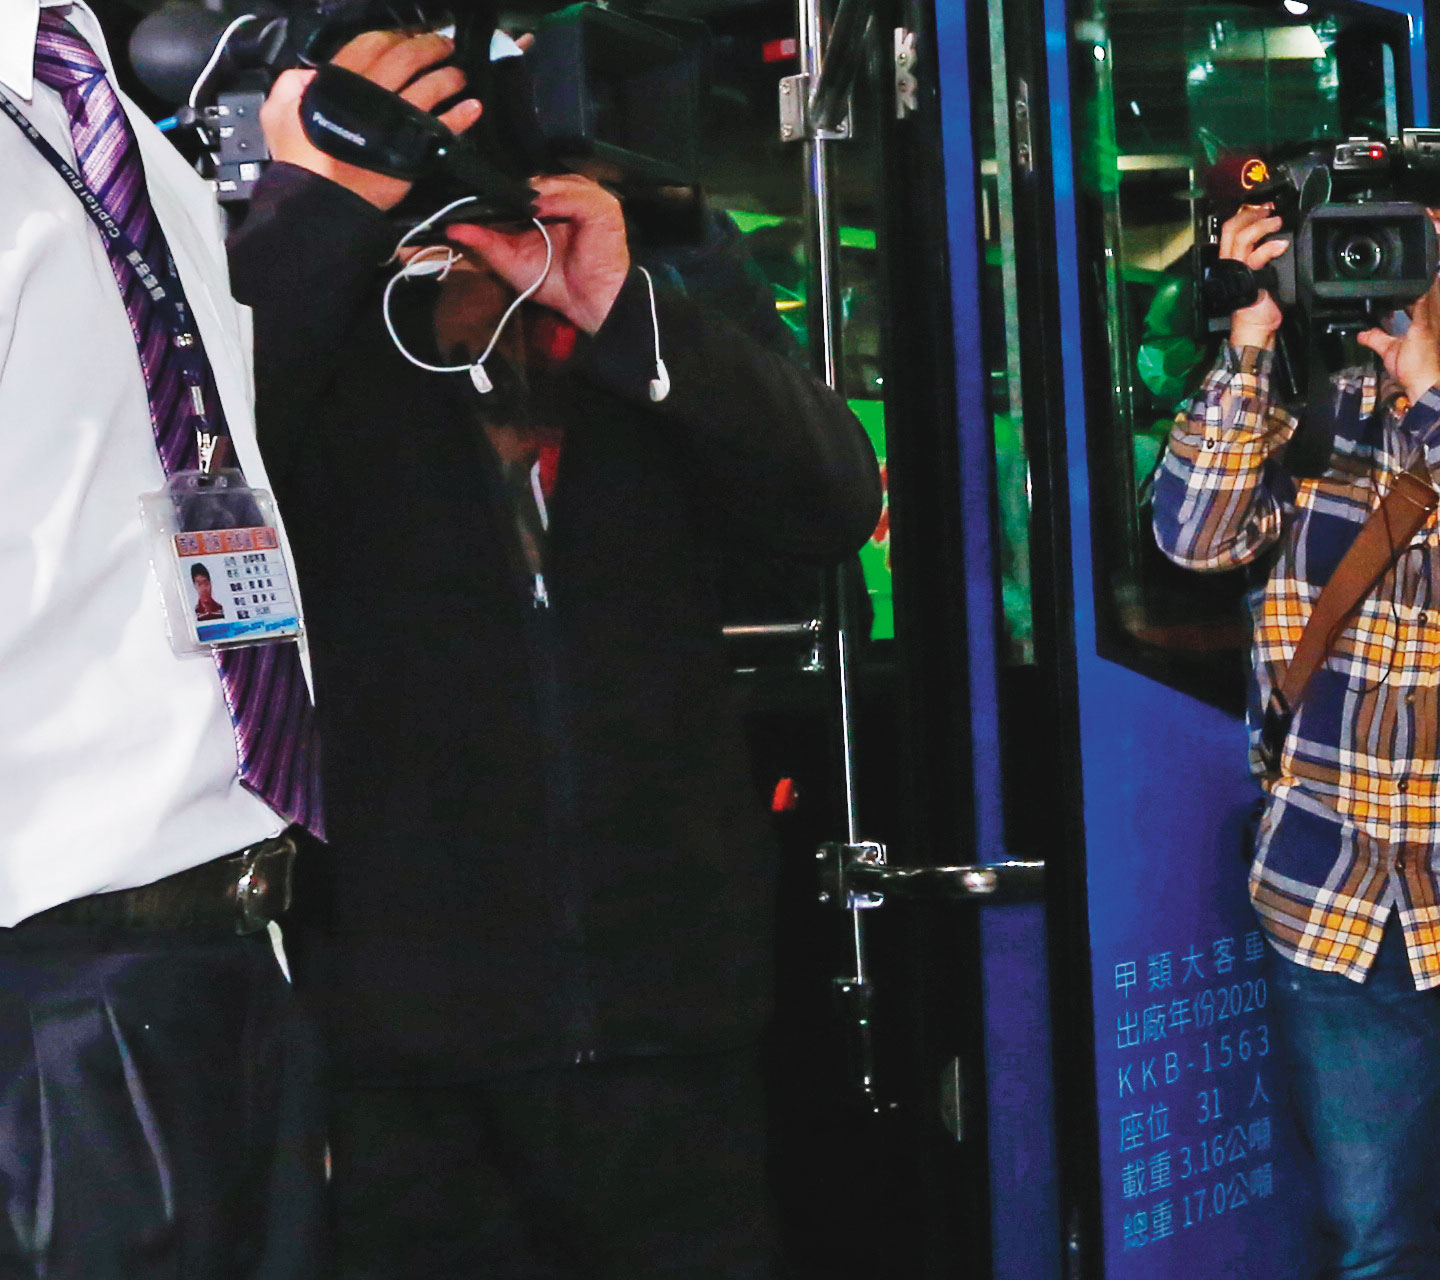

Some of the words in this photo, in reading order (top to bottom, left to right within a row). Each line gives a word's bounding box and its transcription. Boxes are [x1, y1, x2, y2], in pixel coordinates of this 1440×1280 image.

[1115, 930, 1265, 999] 甲類大客車
[1116, 978, 1267, 1049] 出廠年份2020
[1118, 1025, 1269, 1099] KKB-1563
[1120, 1103, 1171, 1153] 座位
[1196, 1089, 1223, 1124] 31
[1248, 1072, 1270, 1108] 人
